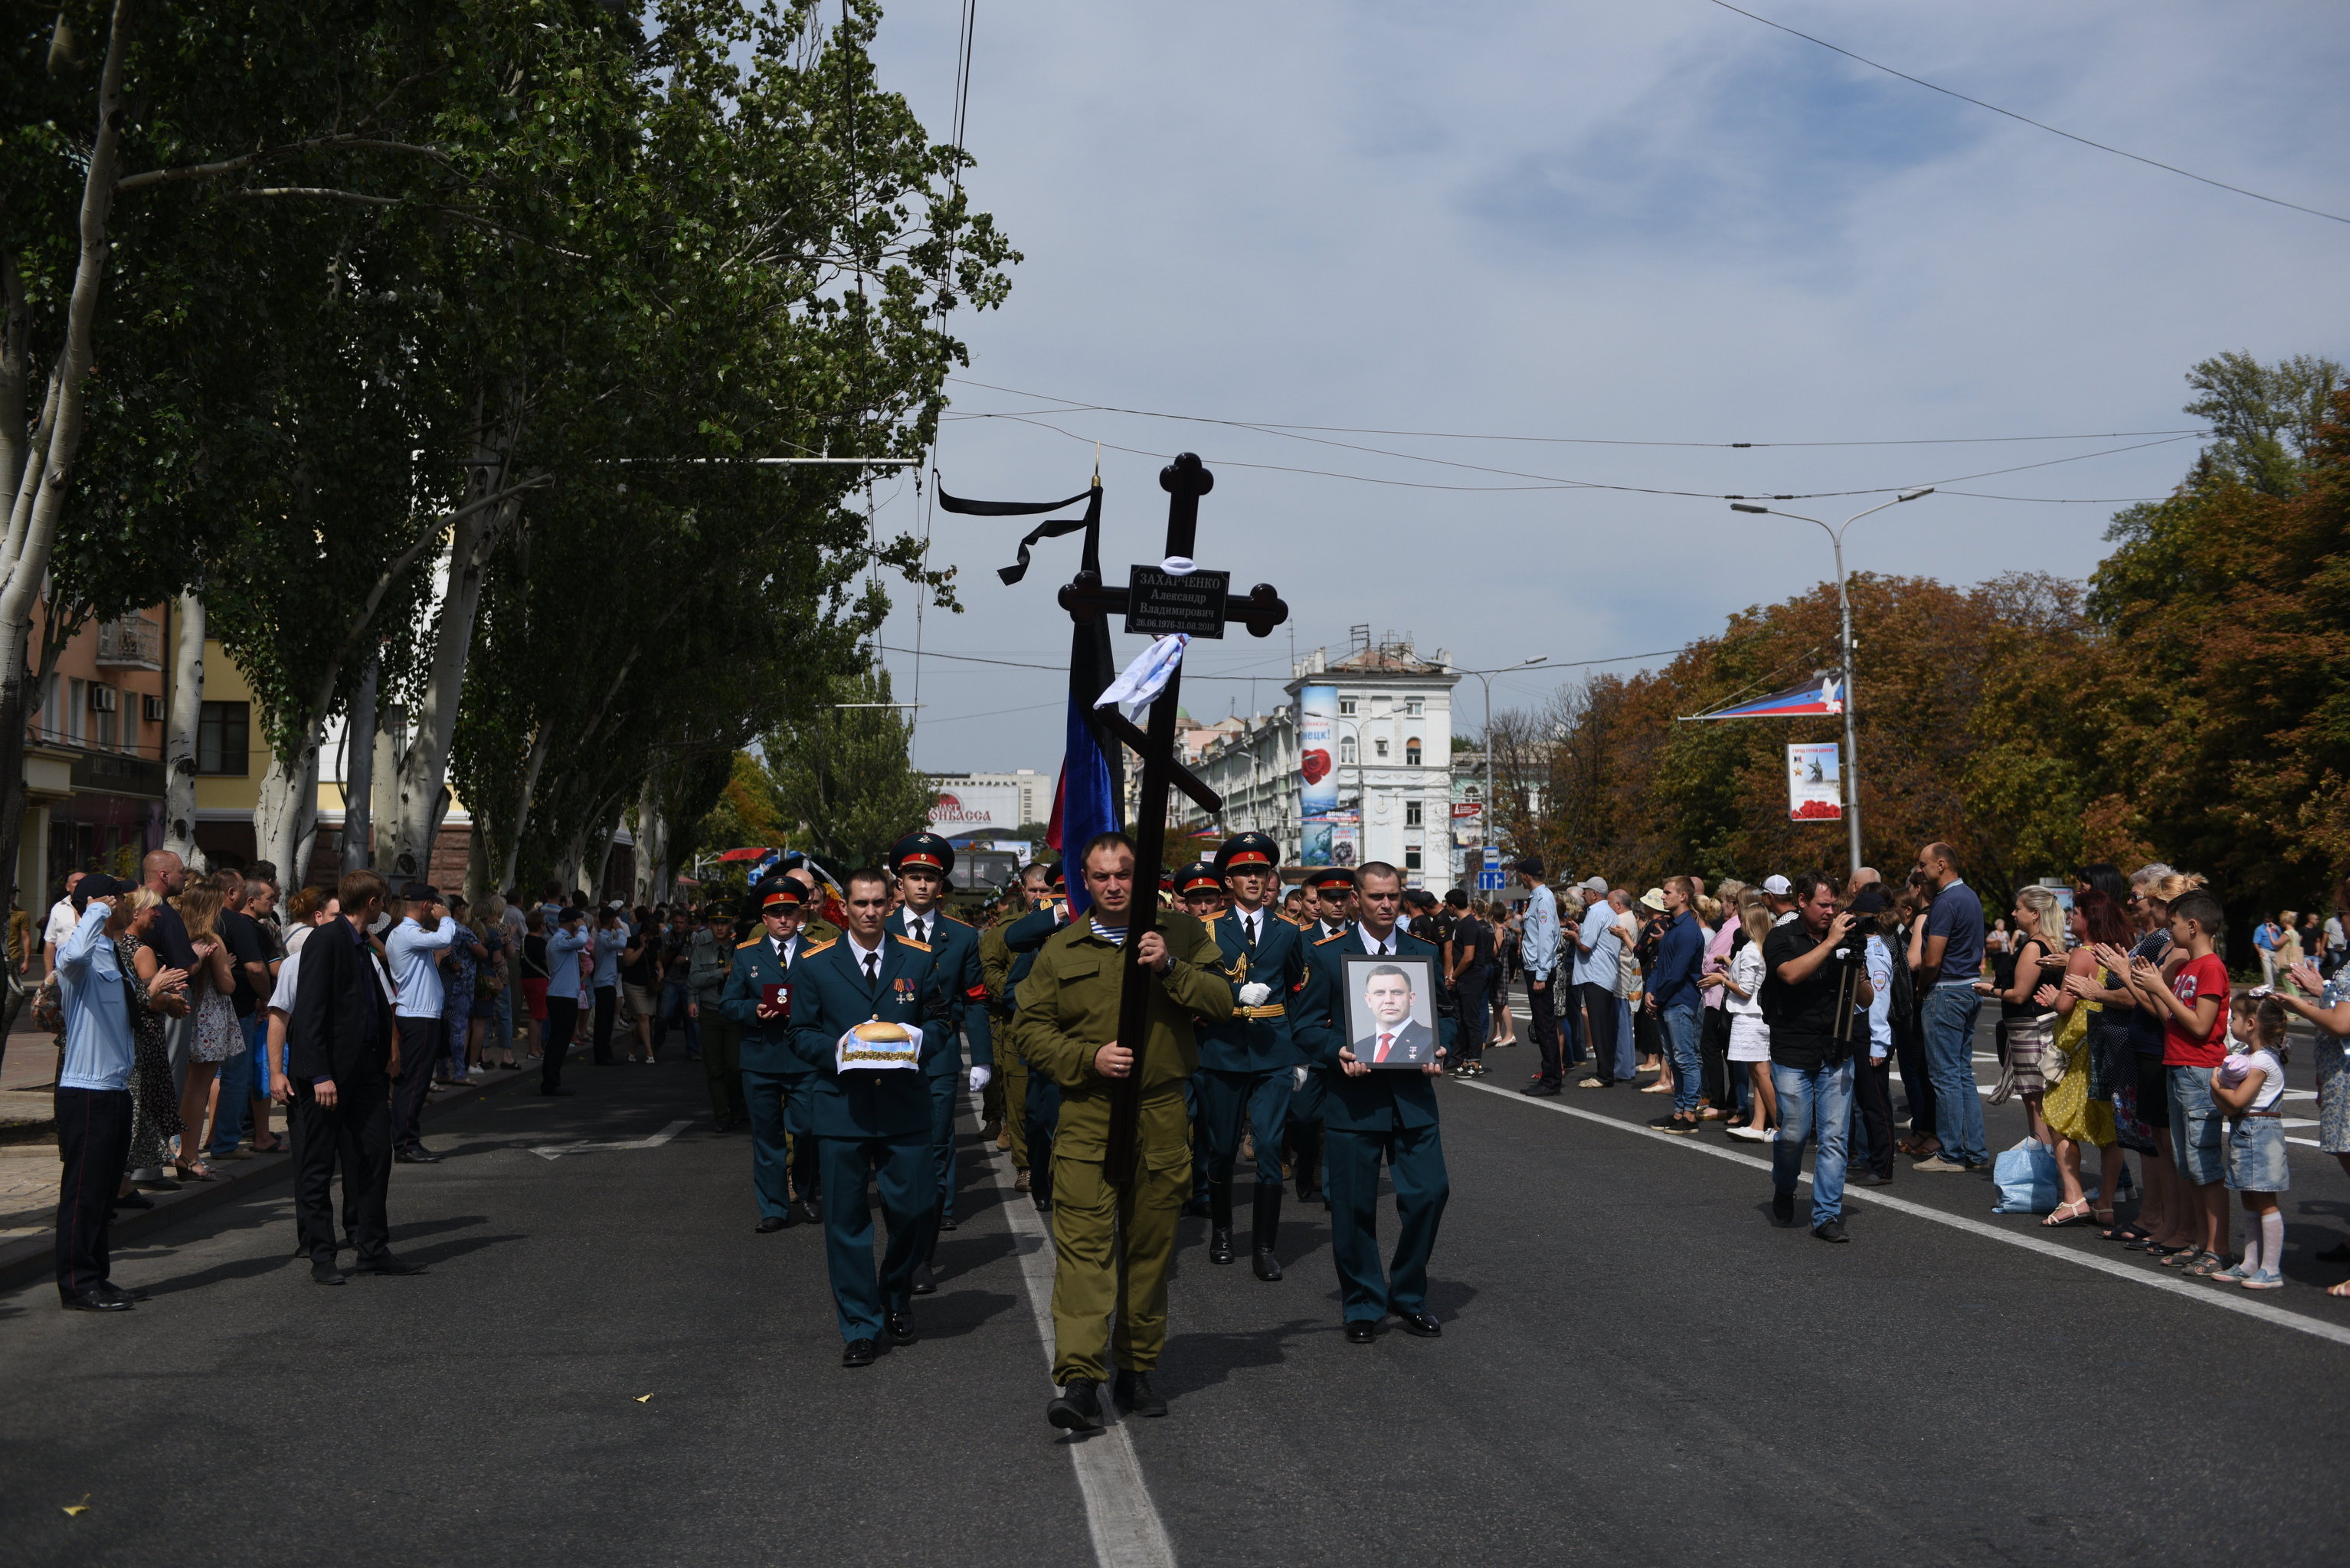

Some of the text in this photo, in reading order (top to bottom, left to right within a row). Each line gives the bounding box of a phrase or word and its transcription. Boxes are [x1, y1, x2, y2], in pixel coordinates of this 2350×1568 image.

[1140, 573, 1220, 589] ЗАХАРЧЕНКО
[1150, 588, 1206, 604] Александр
[1140, 602, 1214, 618] Владимирович
[1136, 618, 1215, 631] 26.06.1976-31.08.2018
[1301, 728, 1330, 741] нецк!
